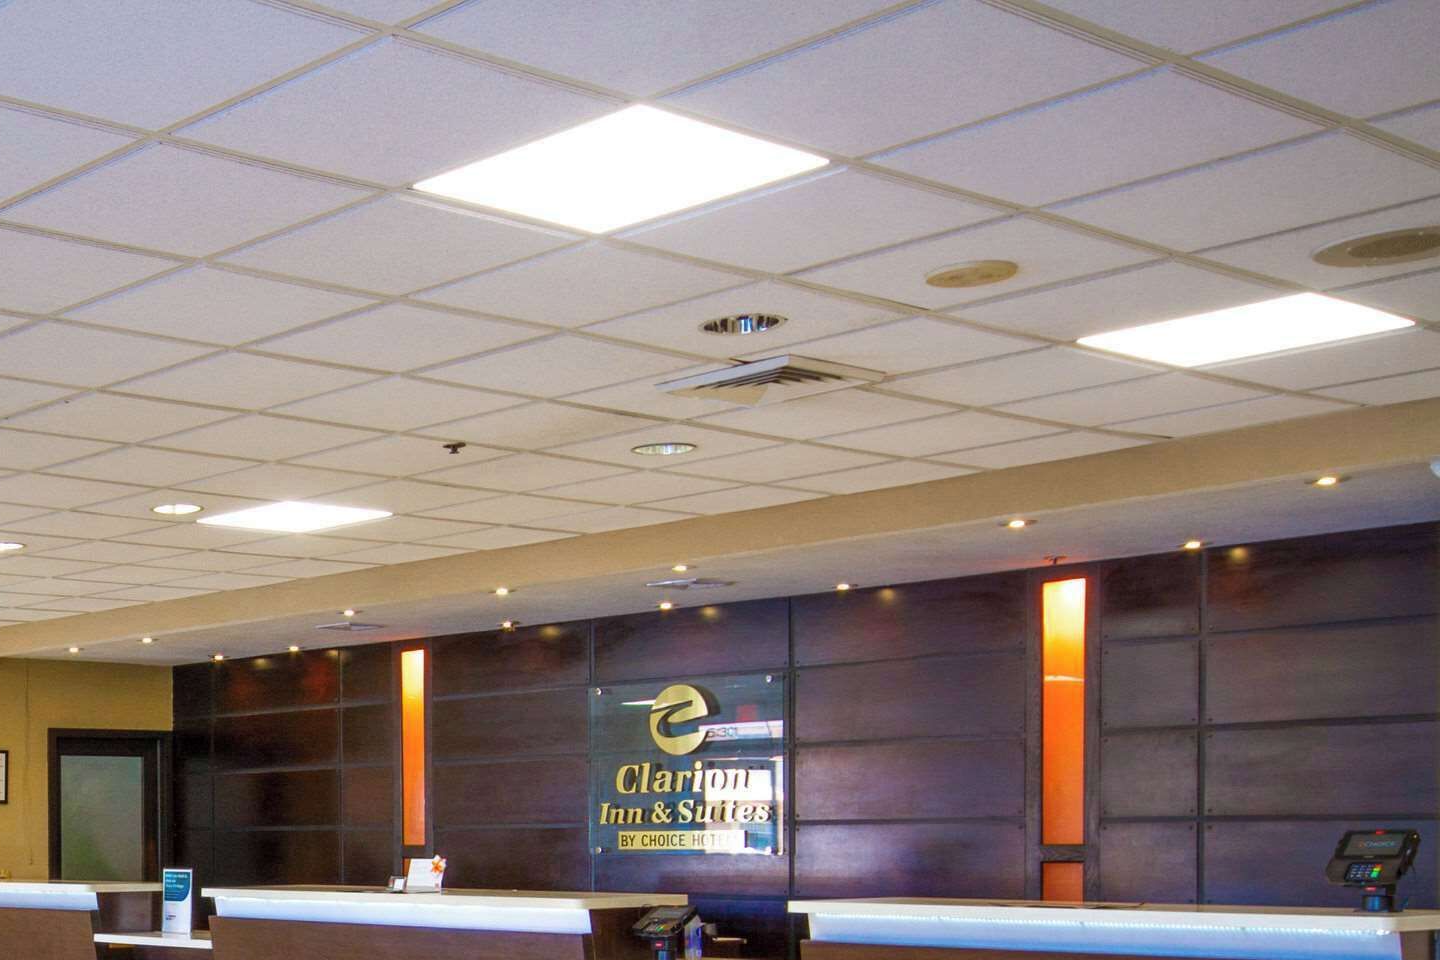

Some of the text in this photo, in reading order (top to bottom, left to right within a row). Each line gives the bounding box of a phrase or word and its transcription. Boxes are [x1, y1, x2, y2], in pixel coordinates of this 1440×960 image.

[616, 761, 749, 794] Clarion
[599, 799, 772, 825] Inn & Suites
[621, 834, 636, 847] BY
[642, 834, 686, 847] CHOICE
